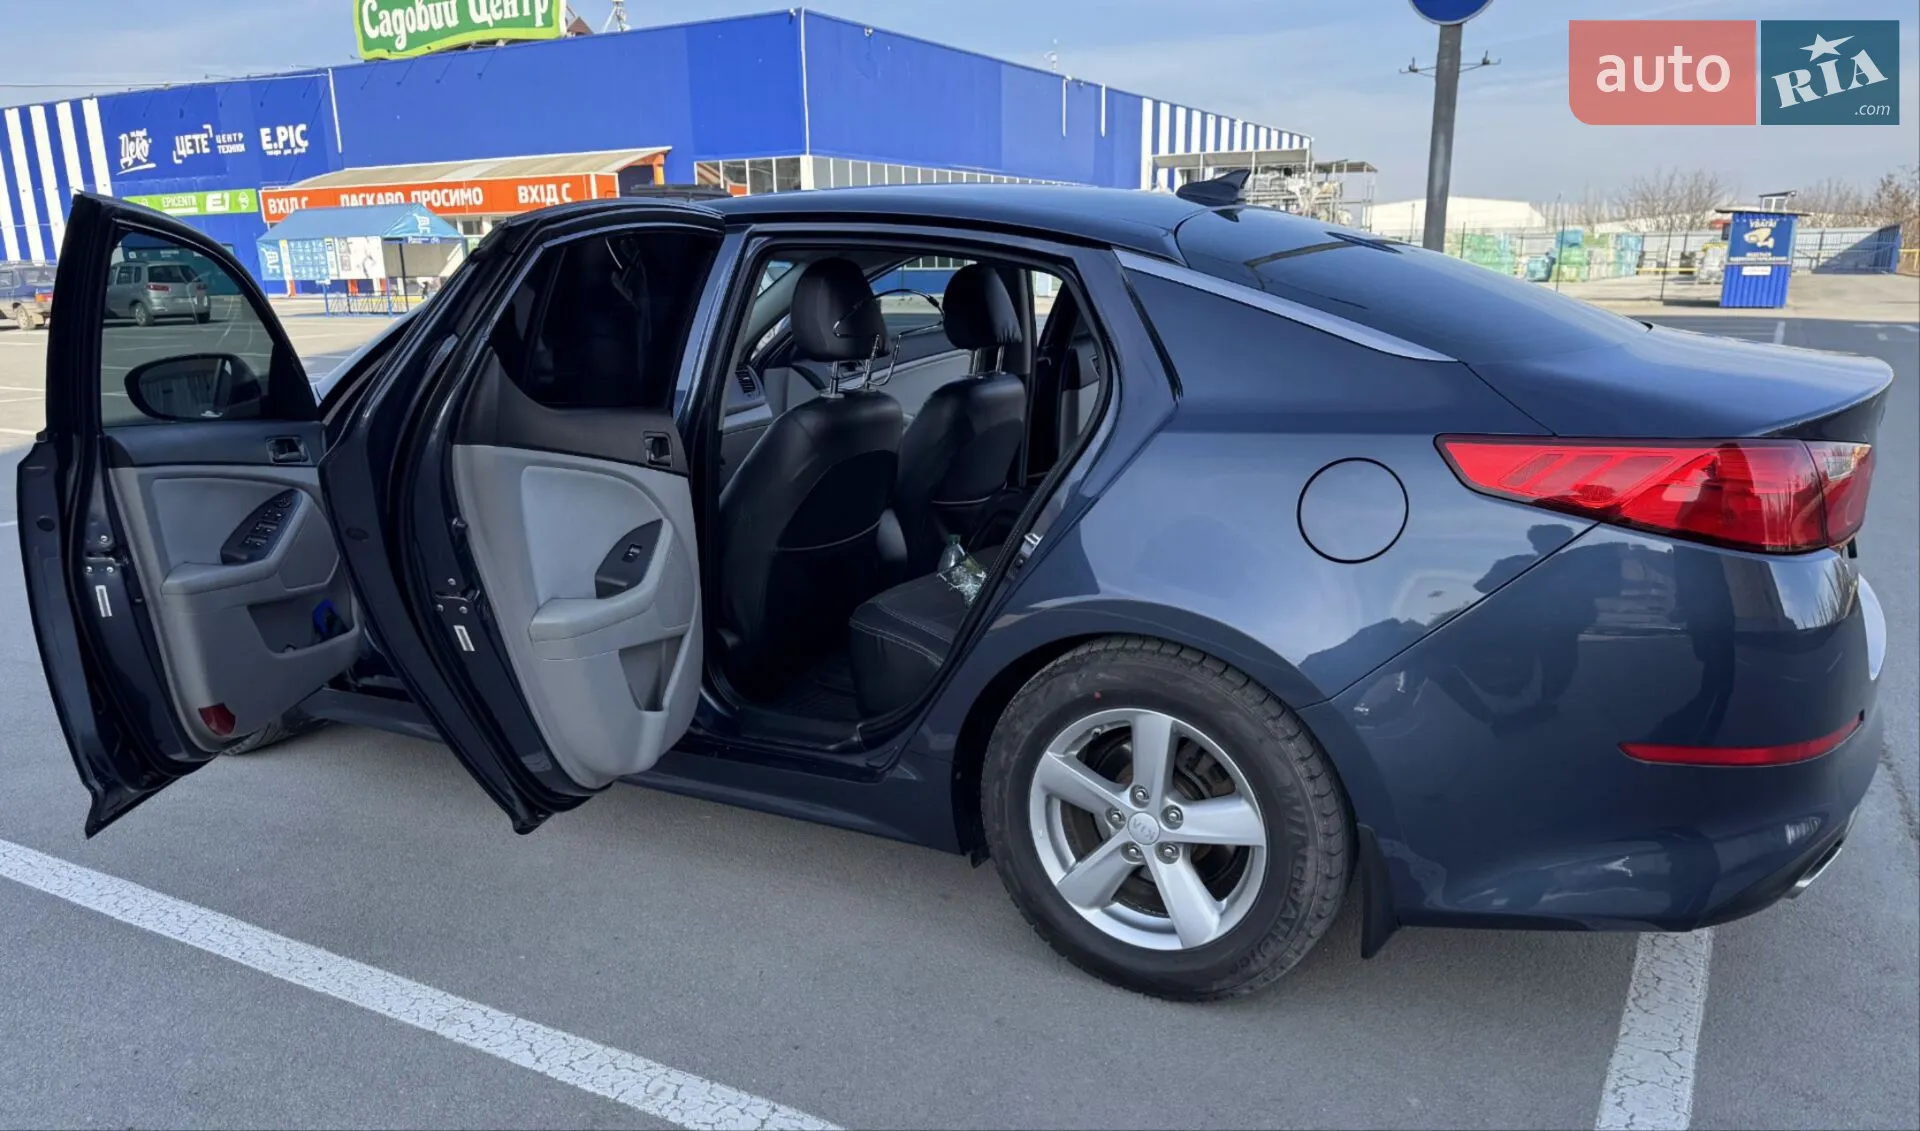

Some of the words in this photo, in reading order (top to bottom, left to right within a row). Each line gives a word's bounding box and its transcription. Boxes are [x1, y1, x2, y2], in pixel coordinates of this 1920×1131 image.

[175, 133, 211, 158] ЦЕТЕ
[215, 132, 244, 144] ЦЕНТР
[410, 186, 484, 208] ПРОСИМО
[517, 183, 559, 206] ВХІД
[561, 182, 573, 203] С
